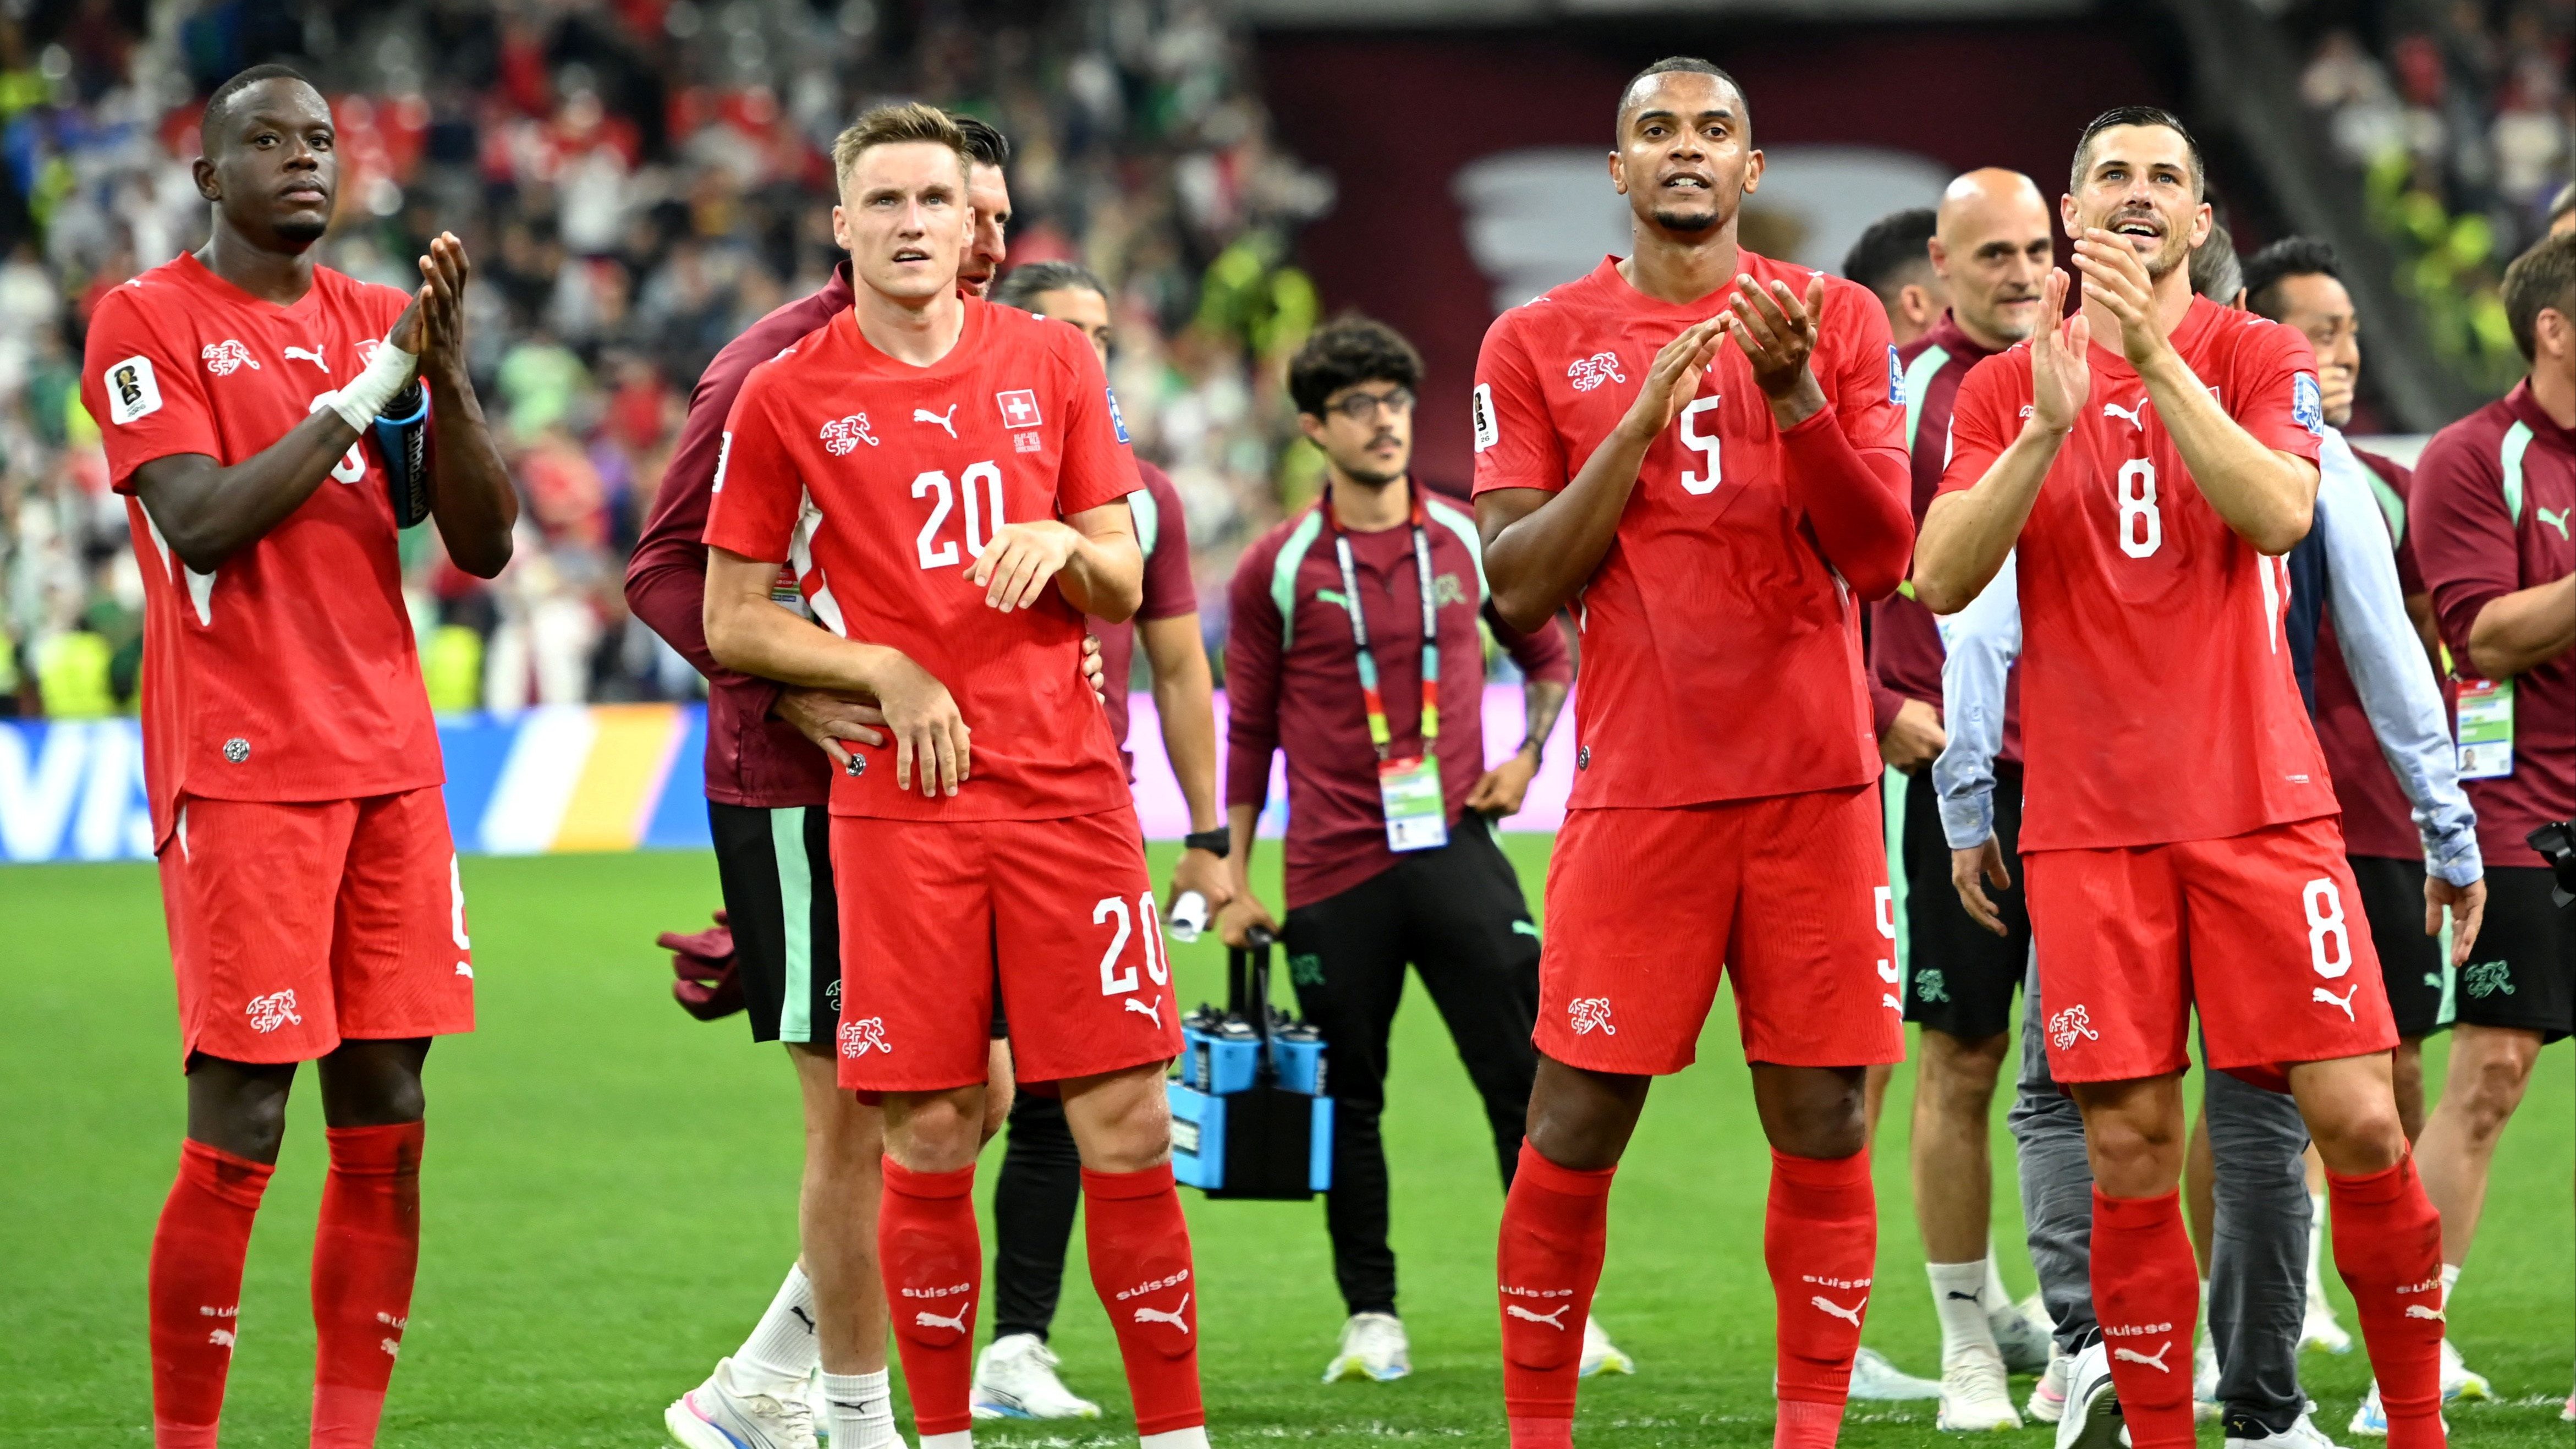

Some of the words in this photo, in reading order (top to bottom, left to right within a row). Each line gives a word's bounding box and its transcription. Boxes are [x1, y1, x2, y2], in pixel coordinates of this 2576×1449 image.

[1680, 394, 1721, 495] 5
[911, 460, 1004, 569] 20
[2118, 457, 2161, 558] 8
[1092, 891, 1168, 996] 20
[1874, 886, 1899, 983] 5
[2302, 876, 2353, 979] 8
[901, 1282, 970, 1298] suisse
[1116, 1269, 1189, 1300] suisse
[2105, 1322, 2172, 1336] suisse
